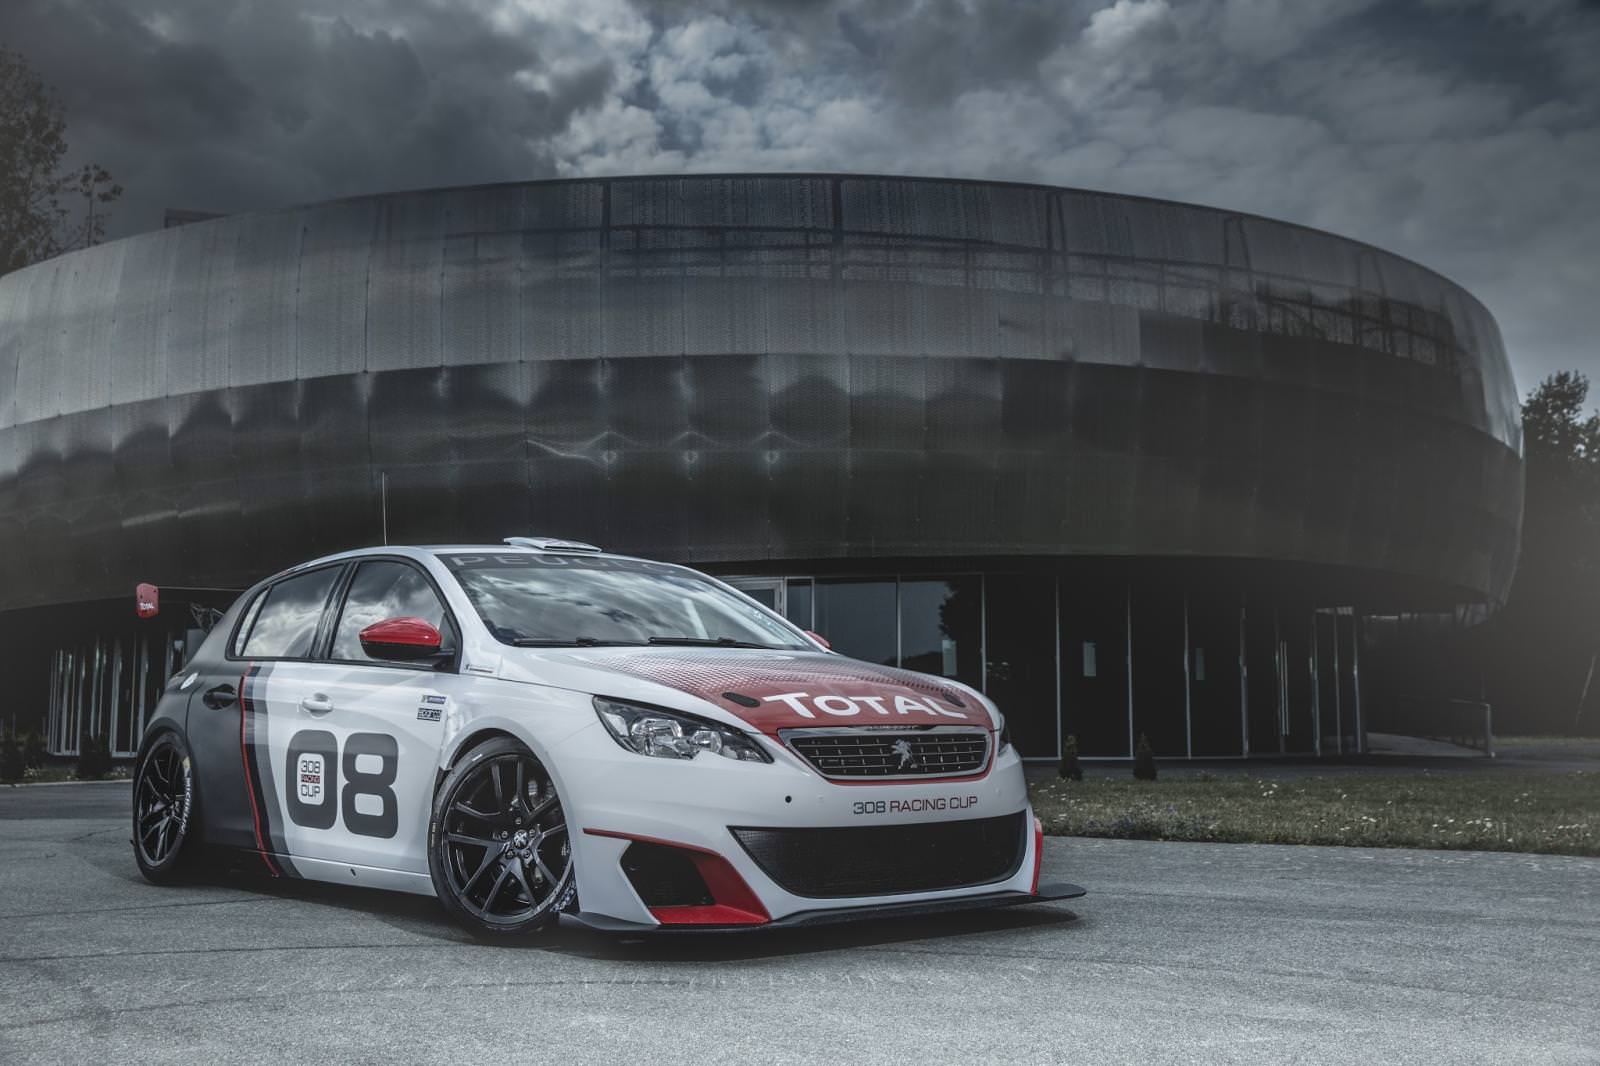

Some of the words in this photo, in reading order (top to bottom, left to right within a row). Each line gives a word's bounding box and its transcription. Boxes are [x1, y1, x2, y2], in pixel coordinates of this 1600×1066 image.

[451, 554, 676, 575] PEUG
[762, 692, 969, 719] TOTAL
[301, 760, 321, 774] 308
[286, 729, 399, 839] 08
[300, 773, 321, 784] RACING
[301, 784, 321, 798] CUP
[853, 801, 886, 815] 308
[890, 797, 947, 813] RACING
[949, 796, 978, 809] CUP
